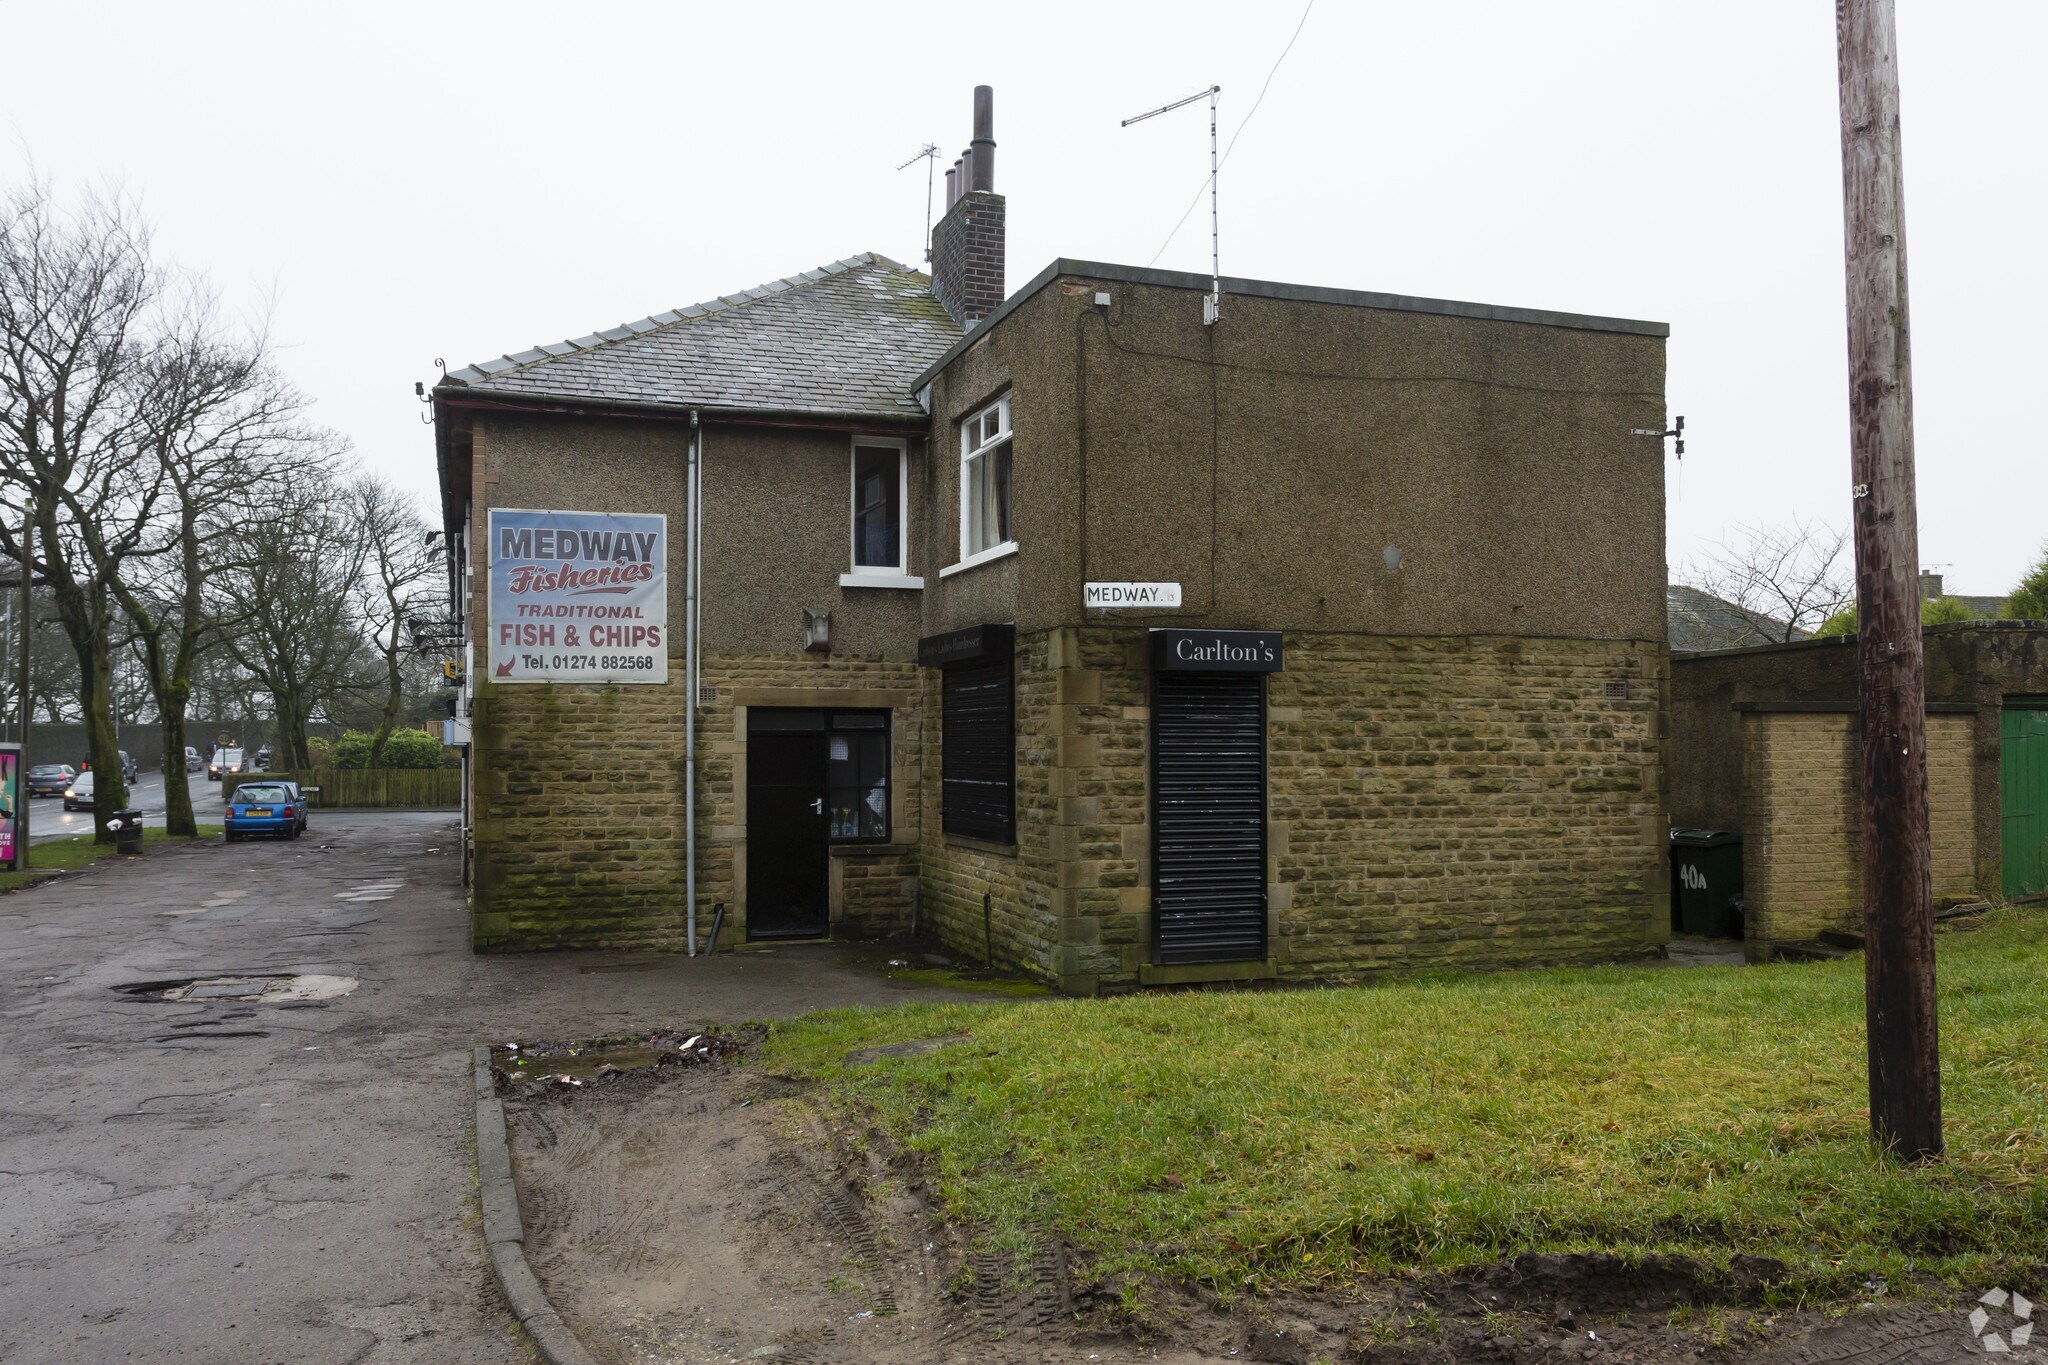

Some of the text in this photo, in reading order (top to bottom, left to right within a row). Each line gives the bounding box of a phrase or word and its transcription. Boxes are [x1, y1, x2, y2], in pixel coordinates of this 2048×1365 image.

[501, 527, 657, 562] MEDWAY
[508, 559, 654, 595] Fisheries
[517, 604, 644, 619] TRADITIONAL
[500, 623, 661, 648] FISH & CHIPS
[522, 654, 653, 670] Tel. 01274 882568
[1176, 638, 1274, 662] Carlton's
[1680, 864, 1707, 889] 40A
